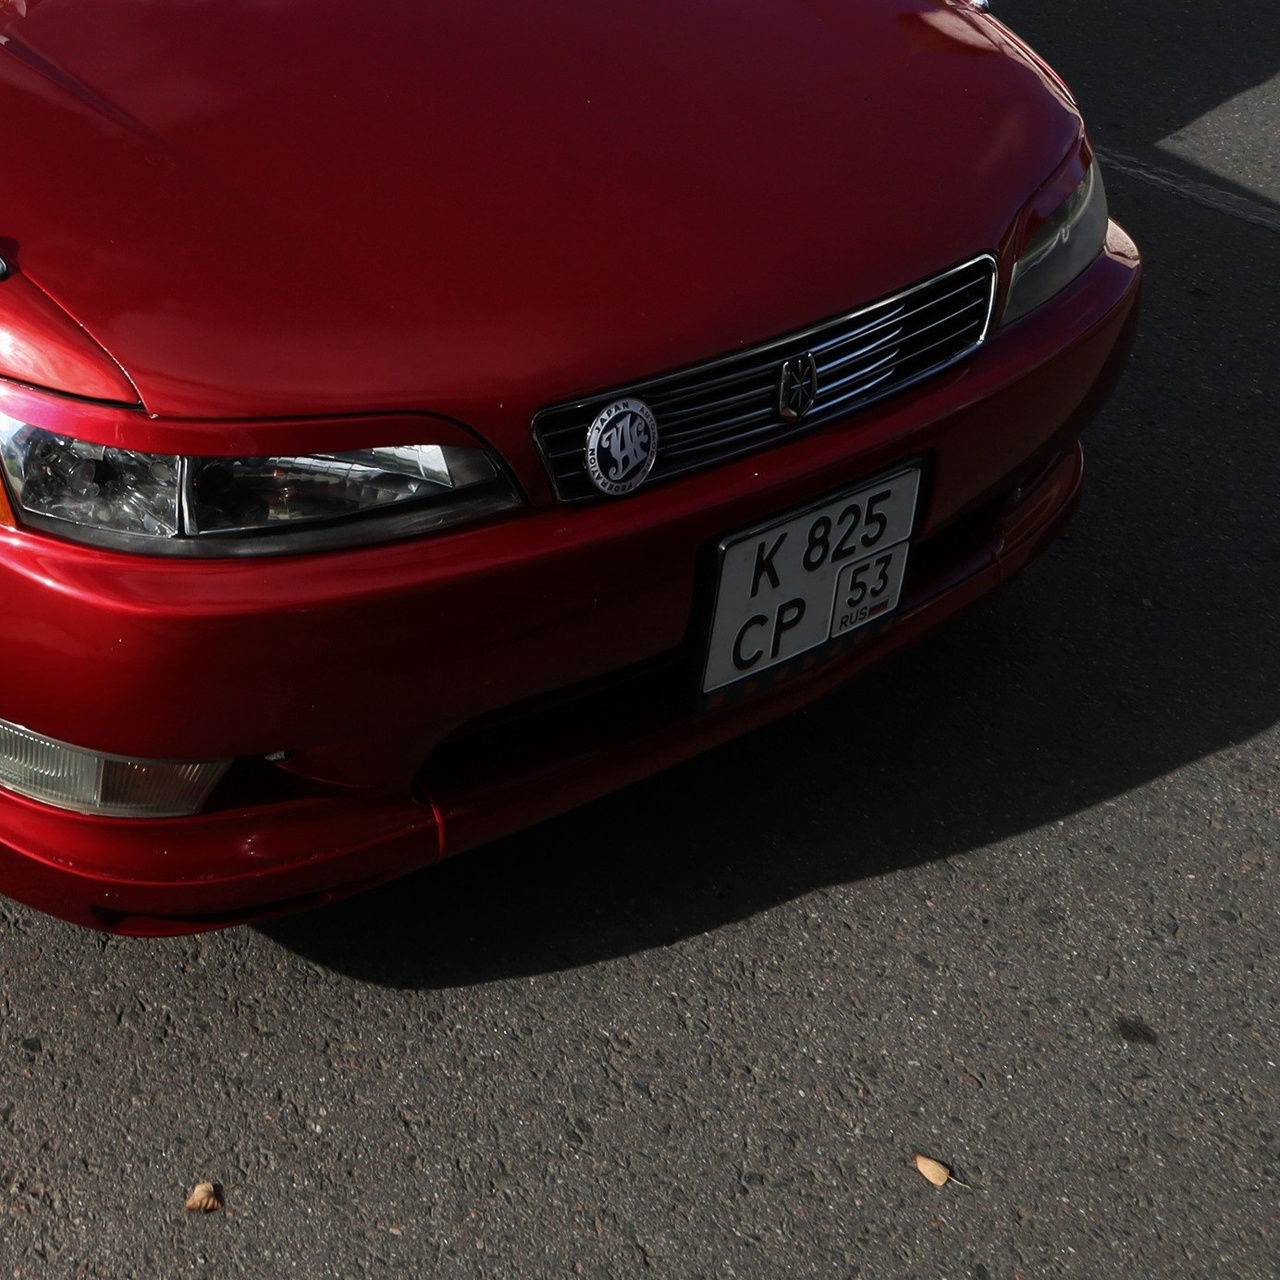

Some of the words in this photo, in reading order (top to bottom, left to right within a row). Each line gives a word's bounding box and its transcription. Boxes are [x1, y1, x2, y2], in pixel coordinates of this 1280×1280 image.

[594, 401, 630, 433] JAPAN
[588, 448, 634, 493] FEDERATION
[802, 489, 892, 572] 825
[846, 553, 893, 607] 53
[839, 606, 869, 631] RUS
